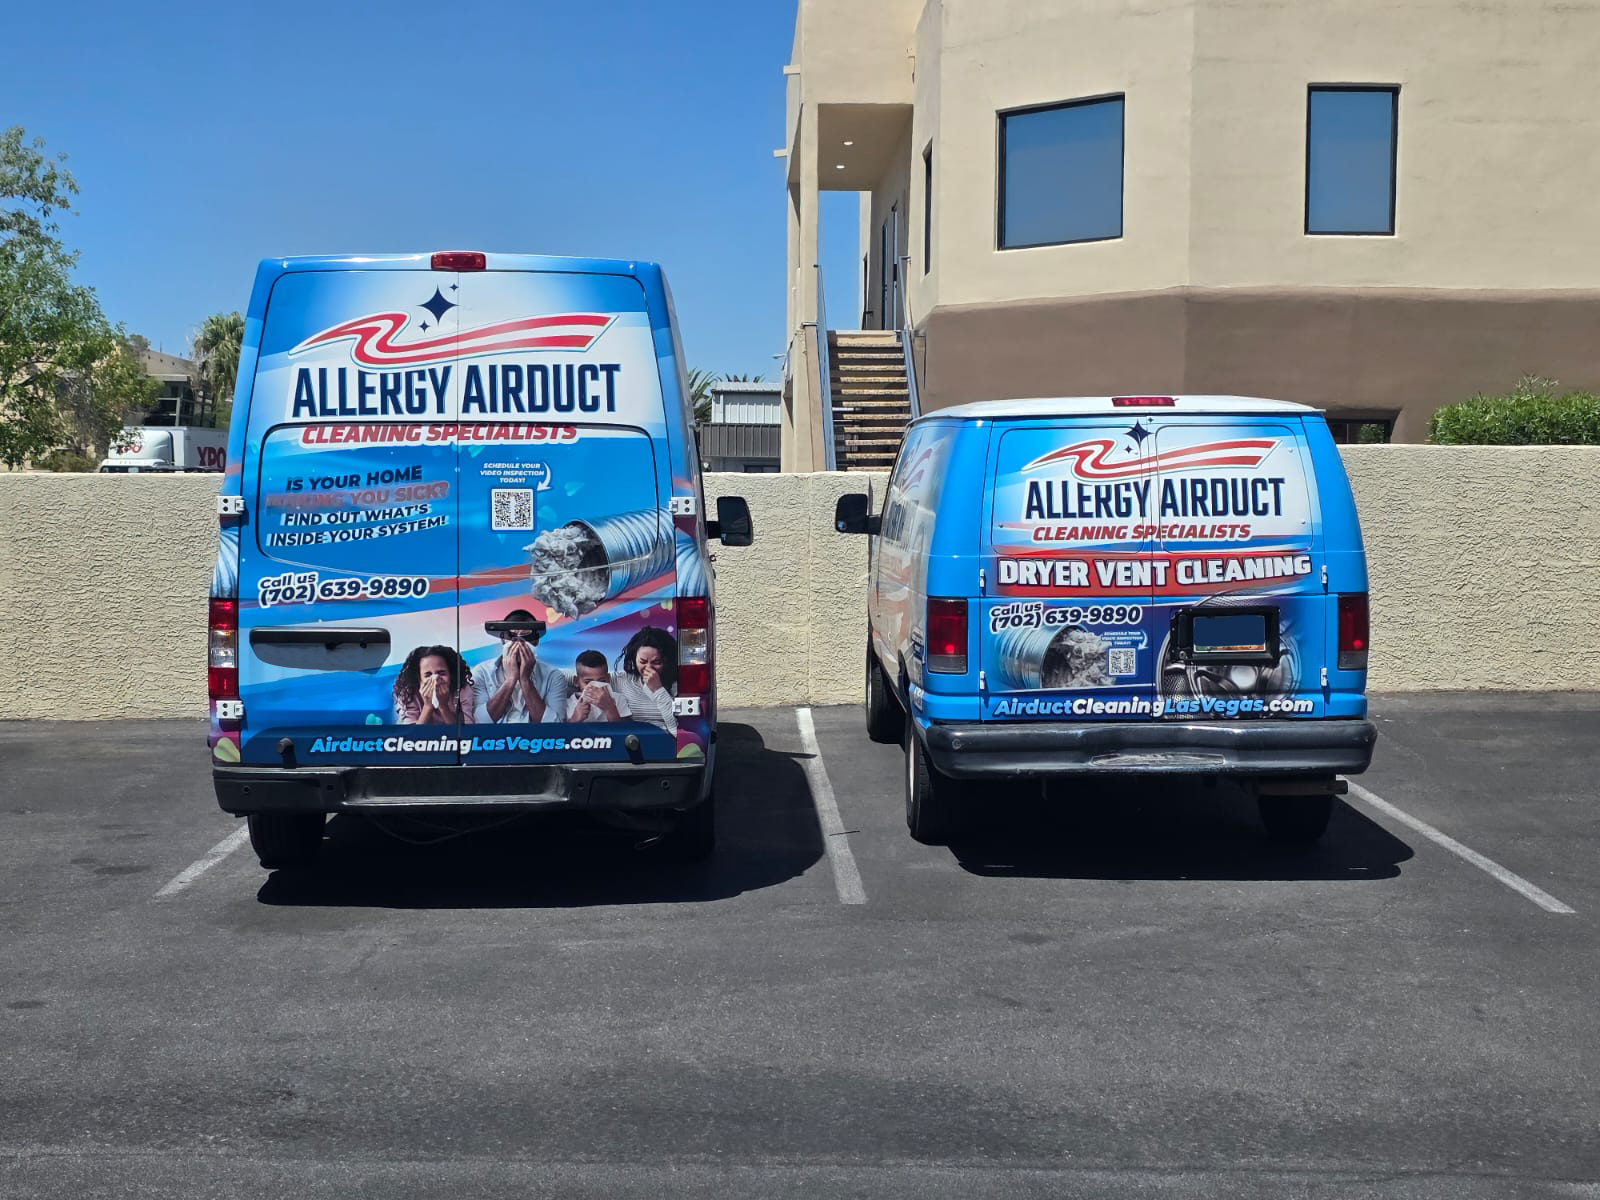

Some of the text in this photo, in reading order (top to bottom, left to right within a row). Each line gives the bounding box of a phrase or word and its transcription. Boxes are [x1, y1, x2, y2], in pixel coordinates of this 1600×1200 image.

[292, 364, 621, 417] ALLERGY AIRDUCT
[302, 423, 577, 445] CLEANING SPECIALISTS
[197, 447, 227, 469] XPO
[286, 465, 422, 491] IS YOUR HOME
[350, 488, 391, 505] YOU
[395, 482, 449, 502] SICK?
[1025, 477, 1285, 519] ALLERGY AIRDUCT
[283, 503, 429, 526] FIND OUT WHAT'S
[269, 515, 447, 546] INSIDE YOUR SYSTEM!
[1032, 523, 1251, 541] CLEANING SPECIALISTS
[260, 574, 317, 589] Call us
[998, 555, 1312, 587] DRYER VENT CLEANING
[260, 578, 427, 606] (702) 639-9890
[991, 603, 1042, 617] Call us
[991, 606, 1141, 633] (702) 639-9890
[994, 696, 1313, 718] AirductCleaningLasVegas.com
[310, 735, 612, 754] AirductCleaningLasVegas.com
